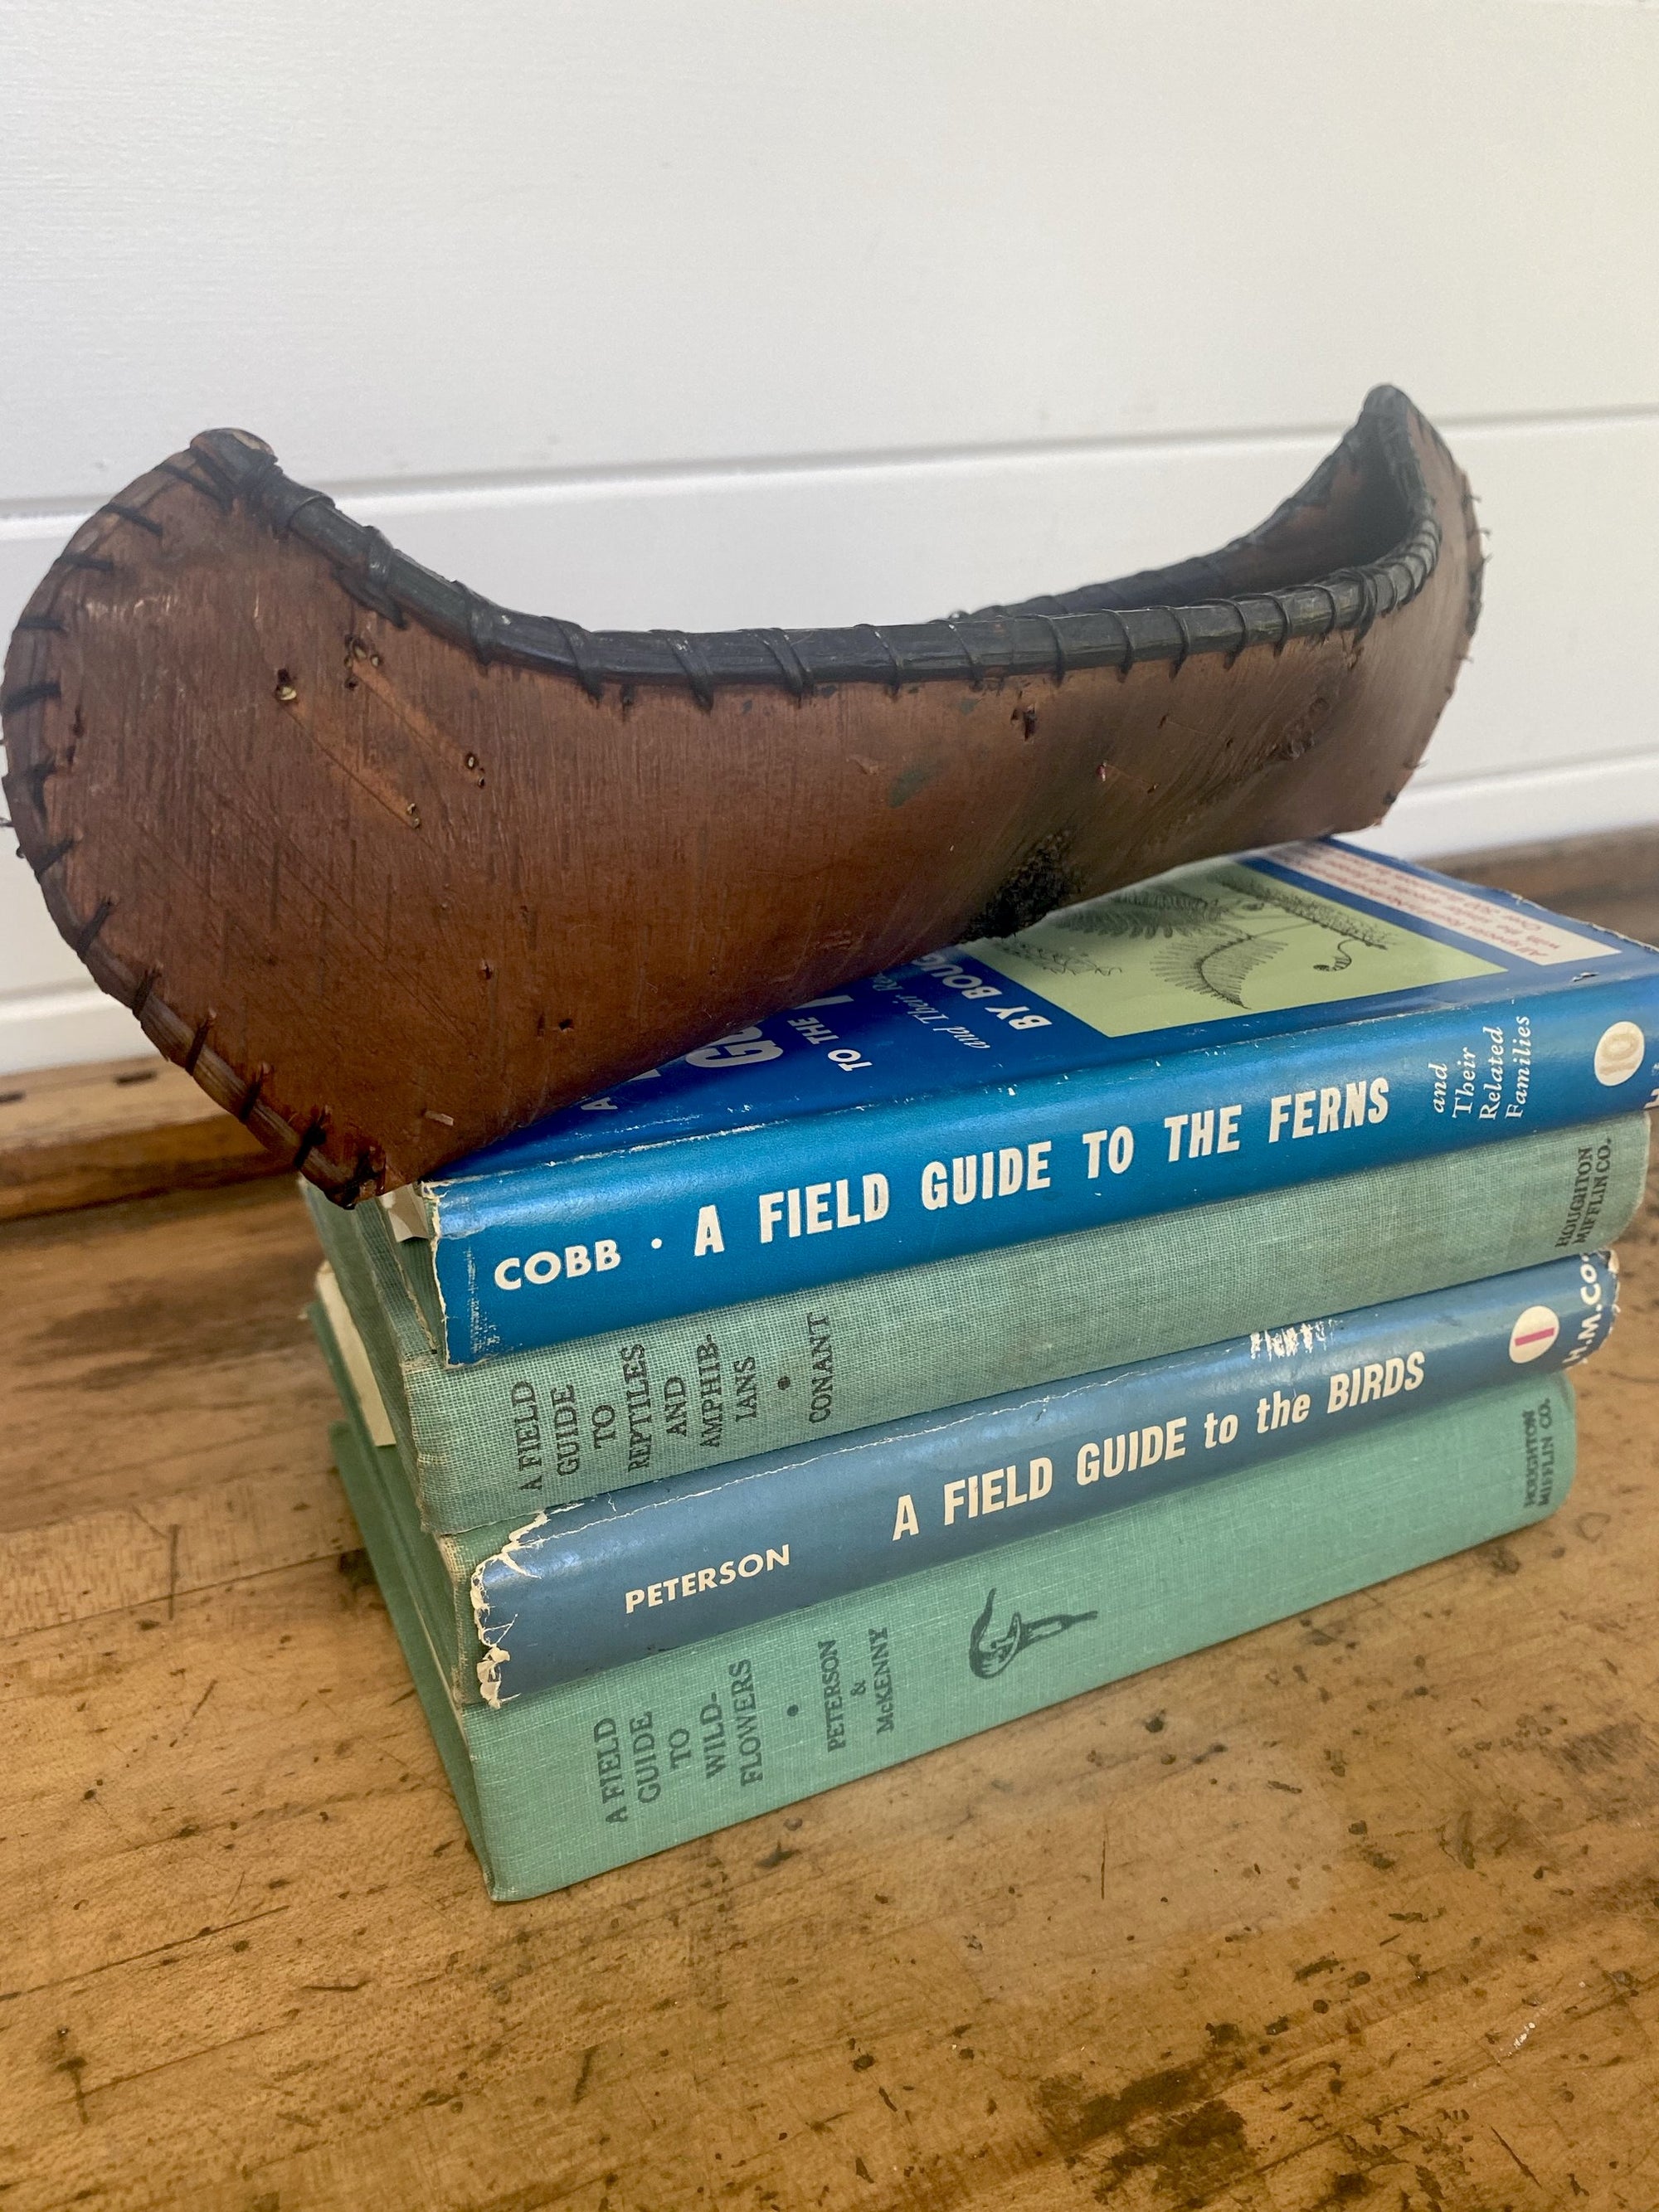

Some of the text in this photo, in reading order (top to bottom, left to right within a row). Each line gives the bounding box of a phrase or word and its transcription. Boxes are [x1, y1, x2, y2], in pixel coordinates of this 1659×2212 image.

[787, 1017, 873, 1072] TO THE
[892, 994, 991, 1049] and Their
[985, 1005, 1053, 1030] BY
[1428, 1062, 1447, 1113] and
[1452, 1047, 1476, 1118] Their
[1479, 1026, 1504, 1120] Related
[1505, 1016, 1531, 1119] Families
[494, 1077, 1389, 1290] COBB A FIELD GUIDE TO THE FERNS
[1554, 1147, 1593, 1247] HOUGHTON
[1571, 1138, 1611, 1244] MIFFLIN CO.
[620, 1344, 653, 1472] REPTILES
[664, 1376, 687, 1437] AND
[697, 1334, 723, 1447] AMPHIB-
[734, 1356, 757, 1422] IANS
[807, 1311, 834, 1423] CONANT
[511, 1381, 542, 1490] A FIELD
[550, 1384, 580, 1476] GUIDE
[591, 1404, 615, 1449] TO
[1521, 1409, 1539, 1508] HOUGHTON
[1537, 1398, 1554, 1506] MIFFLIN CO.
[625, 1351, 1425, 1614] PETERSON A FIELD GUIDE to the BIRDS
[729, 1659, 764, 1787] FLOWERS
[817, 1640, 846, 1753] PETERSON
[850, 1680, 867, 1696] &
[868, 1627, 894, 1734] McKENNY
[594, 1718, 629, 1824] A FIELD
[630, 1711, 661, 1804] GUIDE
[668, 1728, 692, 1770] TO
[700, 1692, 726, 1779] WILD-
